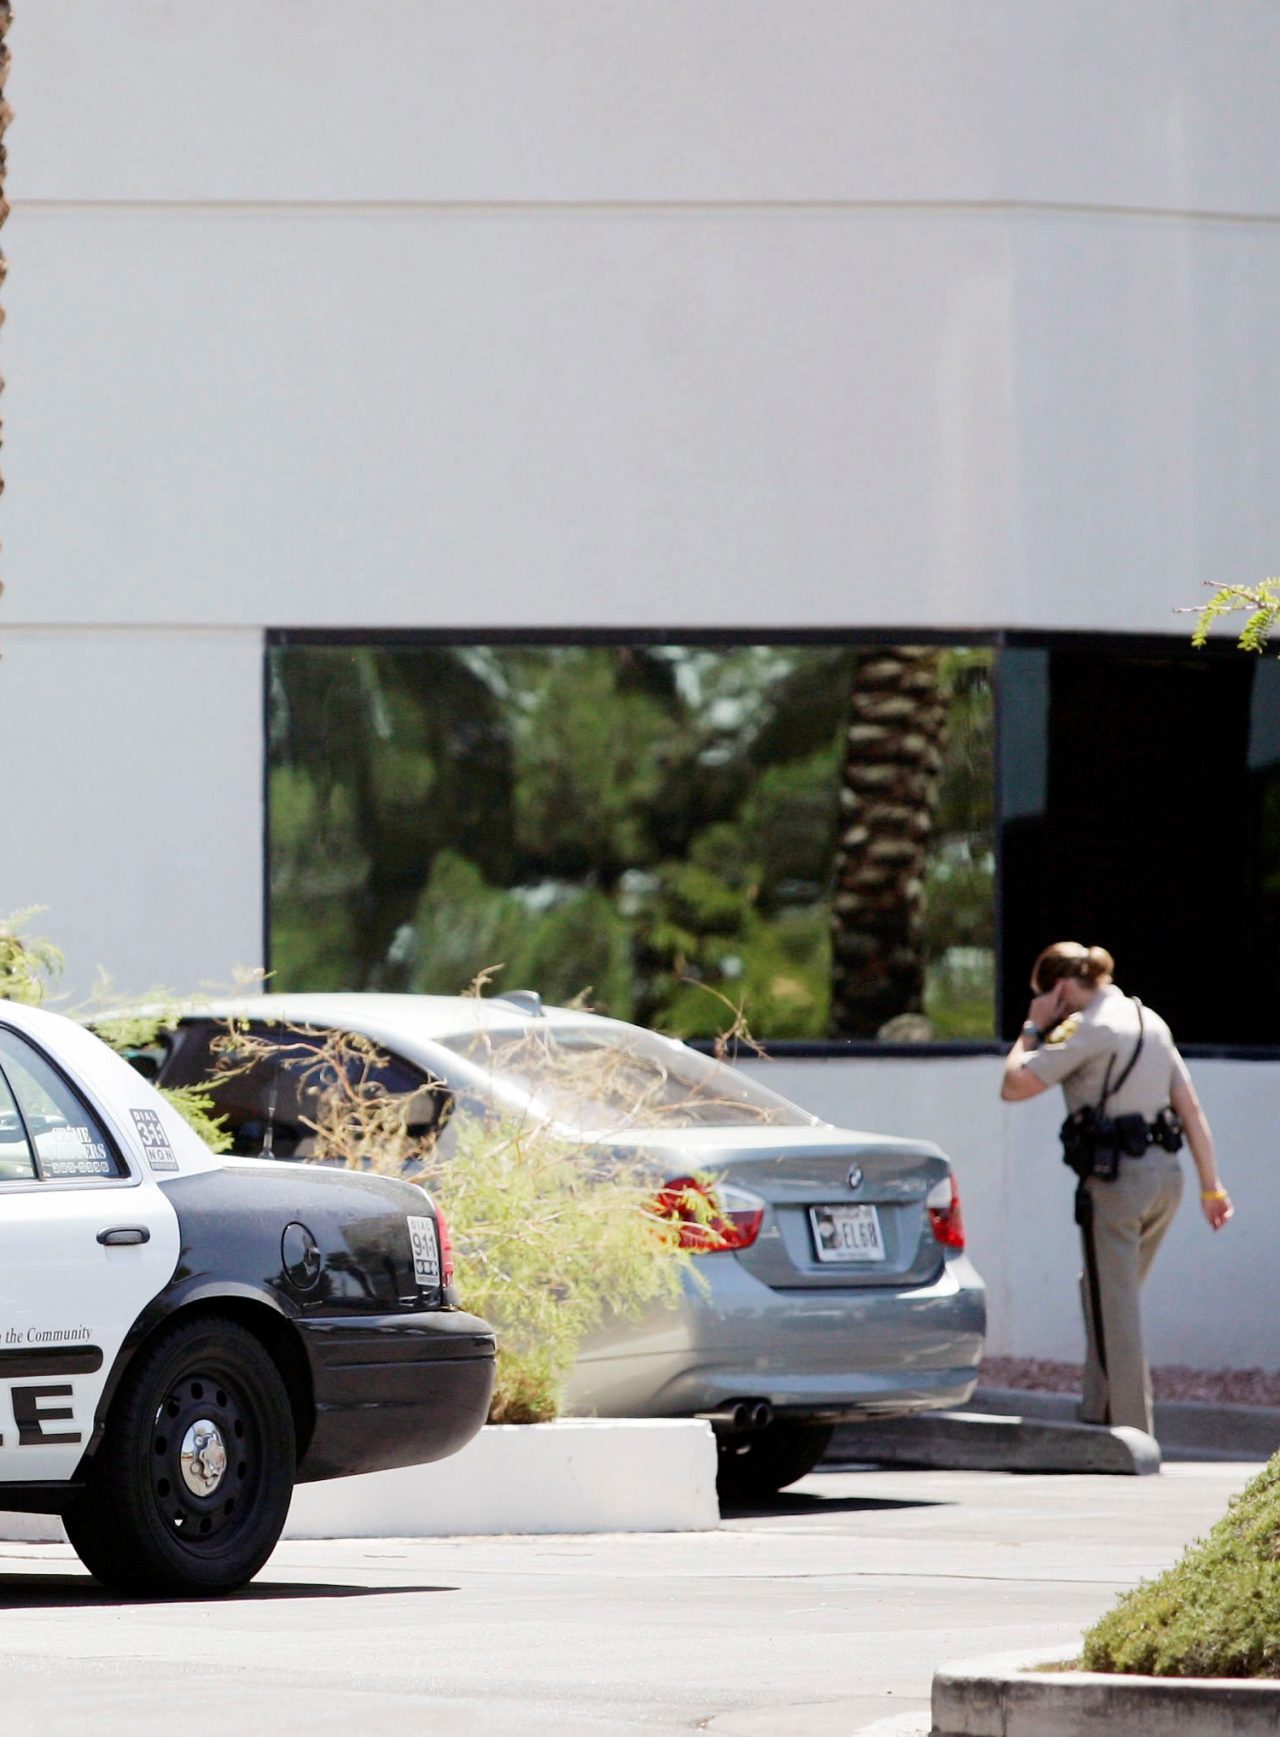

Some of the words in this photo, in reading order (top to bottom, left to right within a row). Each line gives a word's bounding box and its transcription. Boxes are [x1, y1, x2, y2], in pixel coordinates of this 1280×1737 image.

[132, 1111, 158, 1121] DIAL
[6, 1327, 23, 1344] the
[26, 1325, 93, 1343] Community
